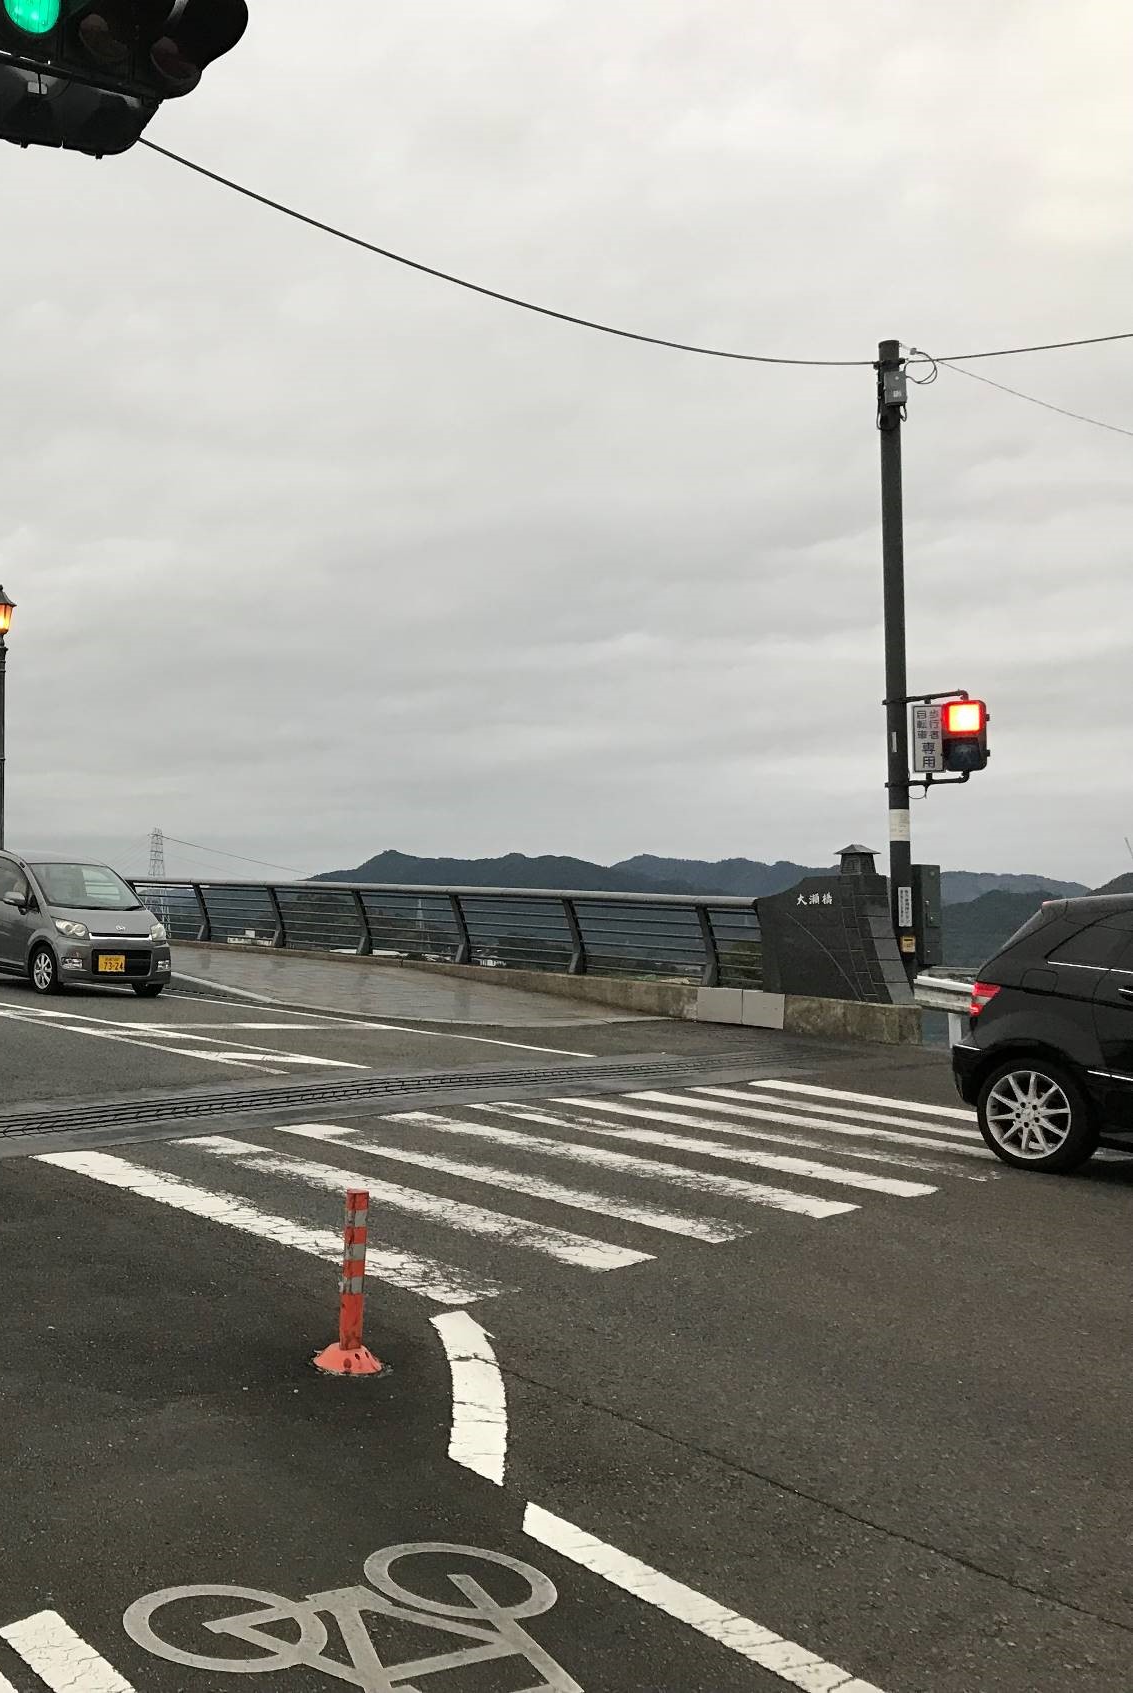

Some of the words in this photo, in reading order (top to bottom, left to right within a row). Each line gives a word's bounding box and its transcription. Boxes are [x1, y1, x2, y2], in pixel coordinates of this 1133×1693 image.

[916, 710, 928, 739] 自転車
[929, 709, 939, 740] 歩行者
[921, 742, 936, 769] 専用
